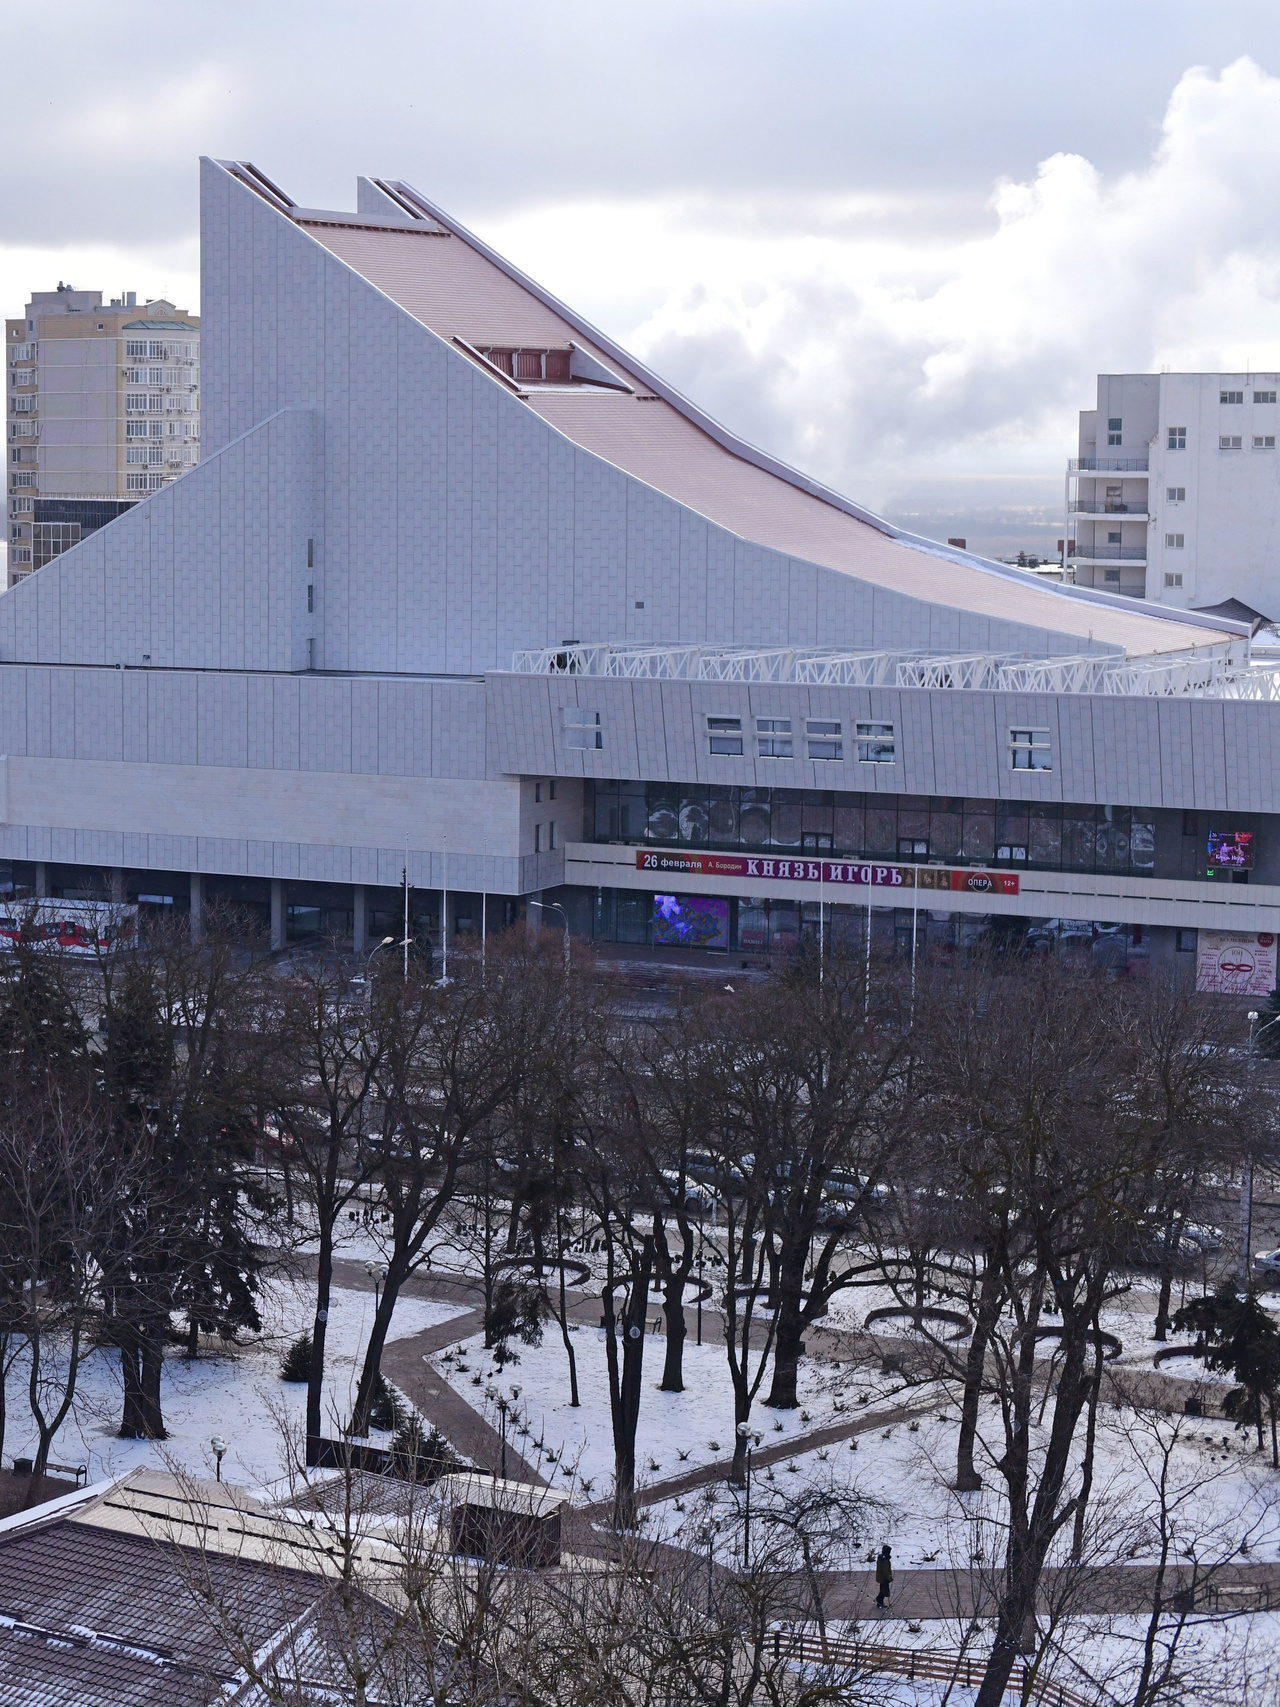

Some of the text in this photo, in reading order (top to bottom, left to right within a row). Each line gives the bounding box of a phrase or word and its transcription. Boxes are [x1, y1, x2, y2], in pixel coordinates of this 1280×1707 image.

[644, 855, 702, 869] 26 февраля
[716, 862, 742, 871] Бородин
[746, 859, 903, 885] КНЯЗЬ ИГОРЬ
[968, 878, 992, 888] ОПЕРА
